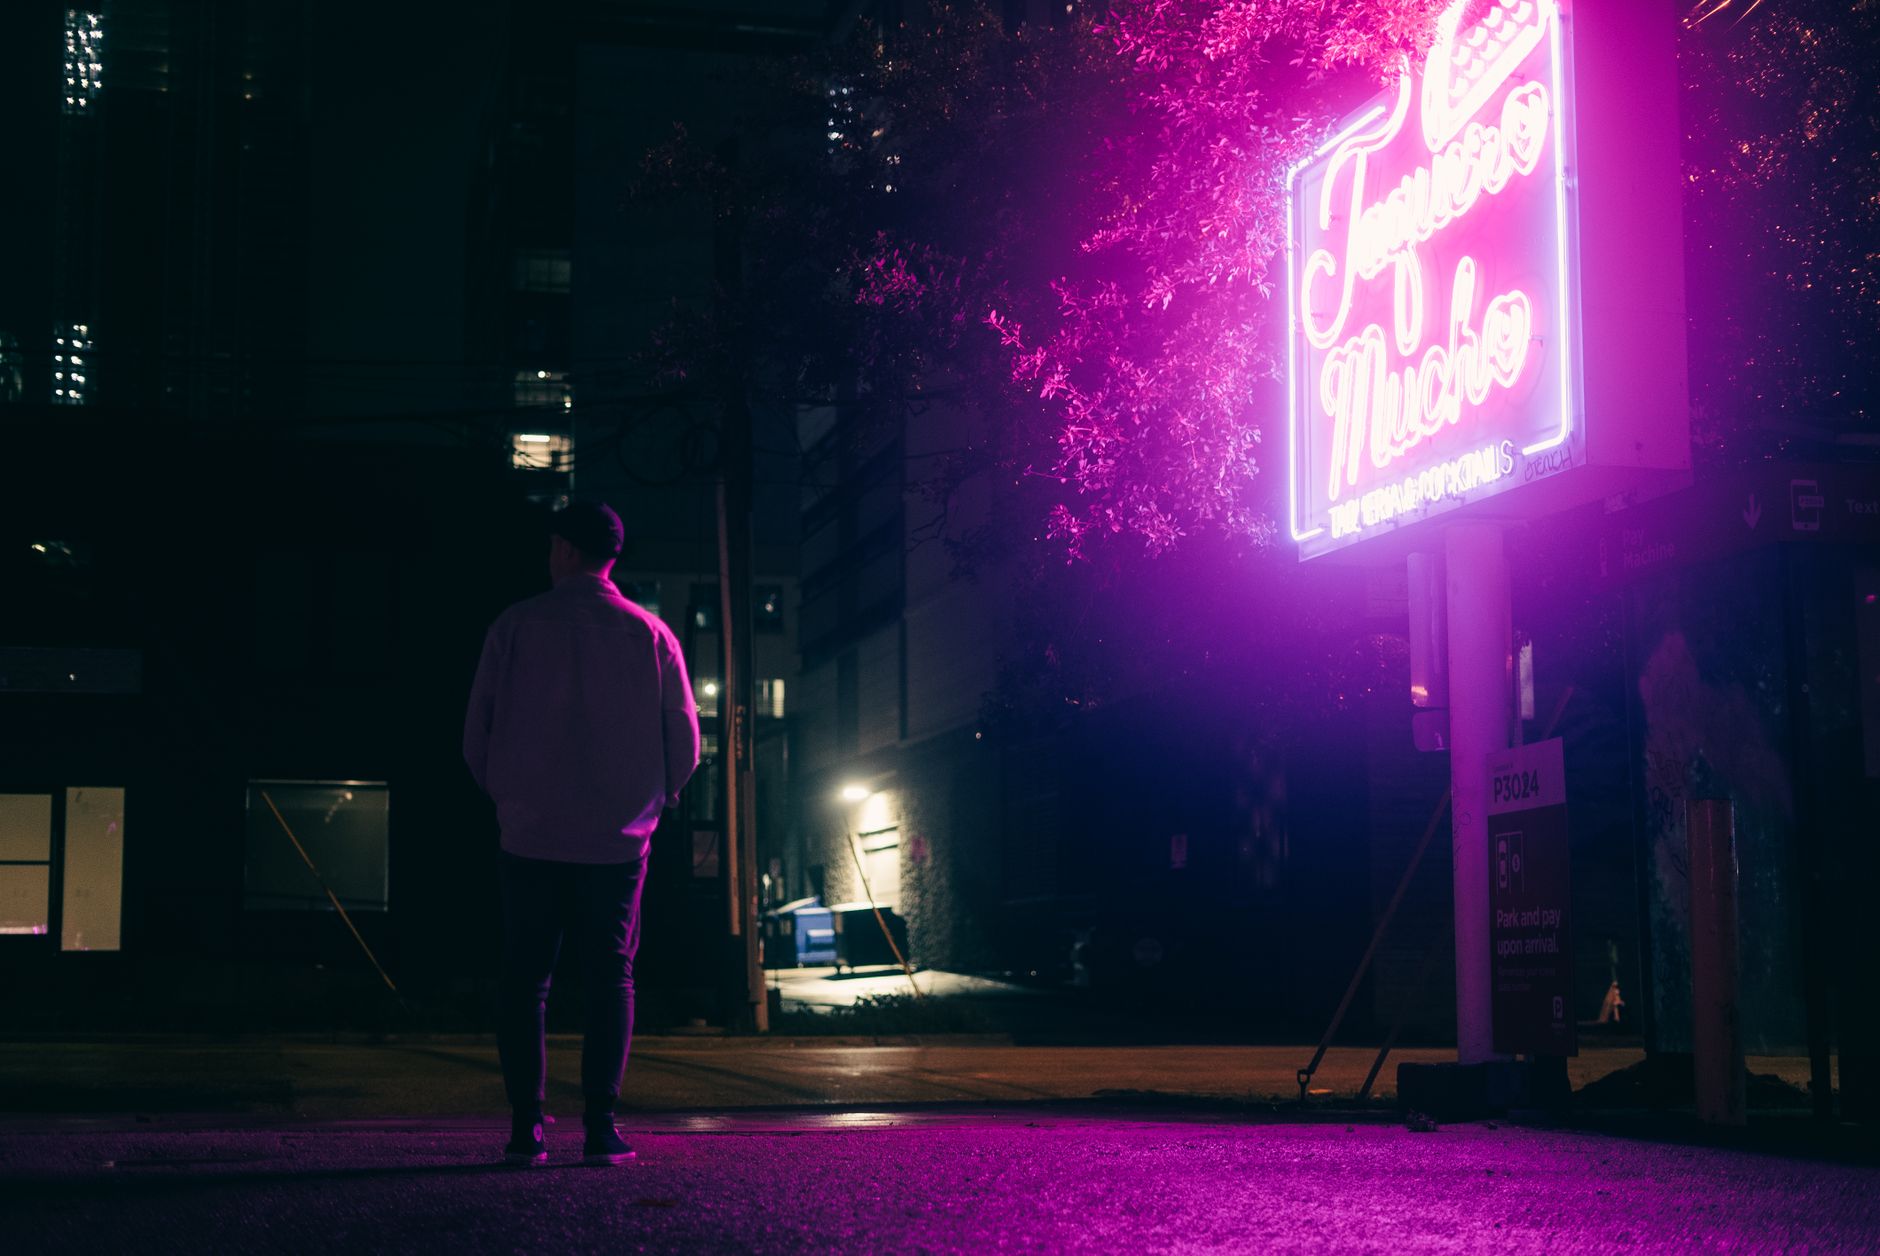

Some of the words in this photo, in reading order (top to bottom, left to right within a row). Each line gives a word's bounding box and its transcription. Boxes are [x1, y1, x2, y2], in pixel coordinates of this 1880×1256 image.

[1320, 256, 1532, 502] Mucho
[1844, 498, 1880, 514] Text
[1494, 769, 1540, 804] P3024
[1496, 905, 1518, 929] Park
[1521, 906, 1540, 926] and
[1542, 908, 1561, 931] pay
[1497, 938, 1523, 959] upon
